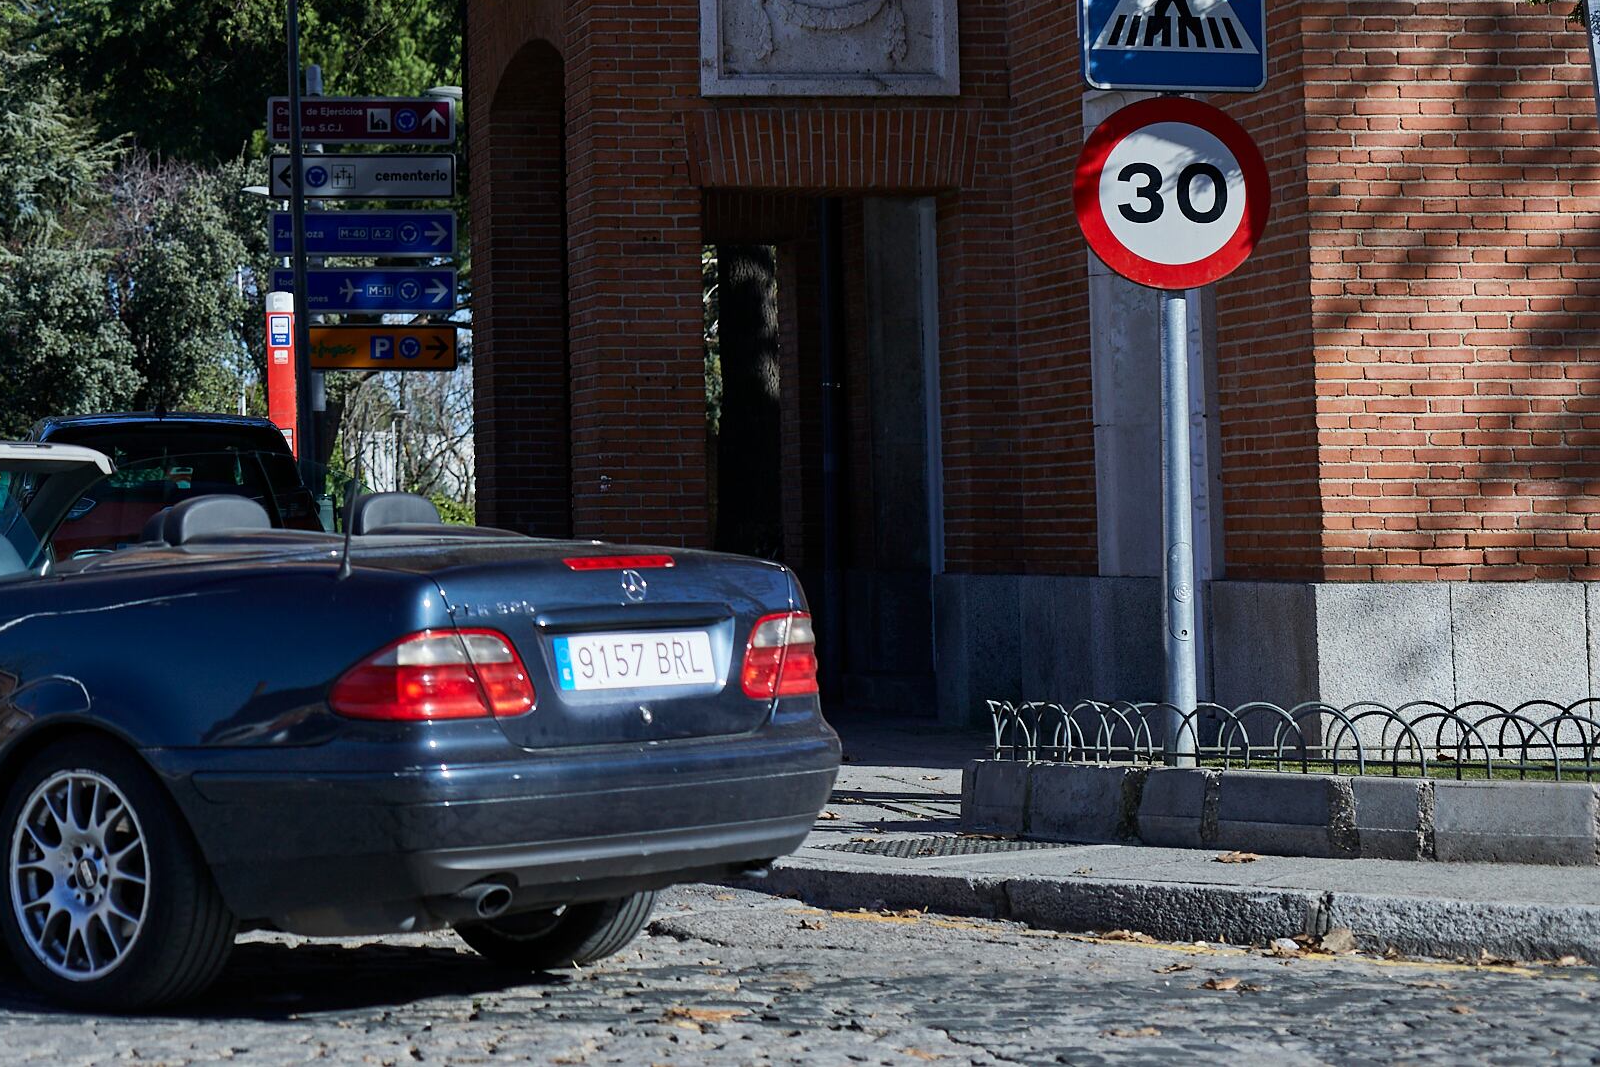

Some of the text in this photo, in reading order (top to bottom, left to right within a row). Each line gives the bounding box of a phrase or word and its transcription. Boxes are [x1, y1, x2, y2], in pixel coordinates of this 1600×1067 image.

[306, 107, 318, 116] de
[320, 107, 363, 118] Ejercicios
[276, 123, 315, 132] Esvas
[375, 169, 448, 182] cementerio
[1117, 162, 1228, 224] 30
[368, 286, 392, 295] M-11
[578, 643, 644, 679] 9157
[656, 640, 704, 675] BRL
